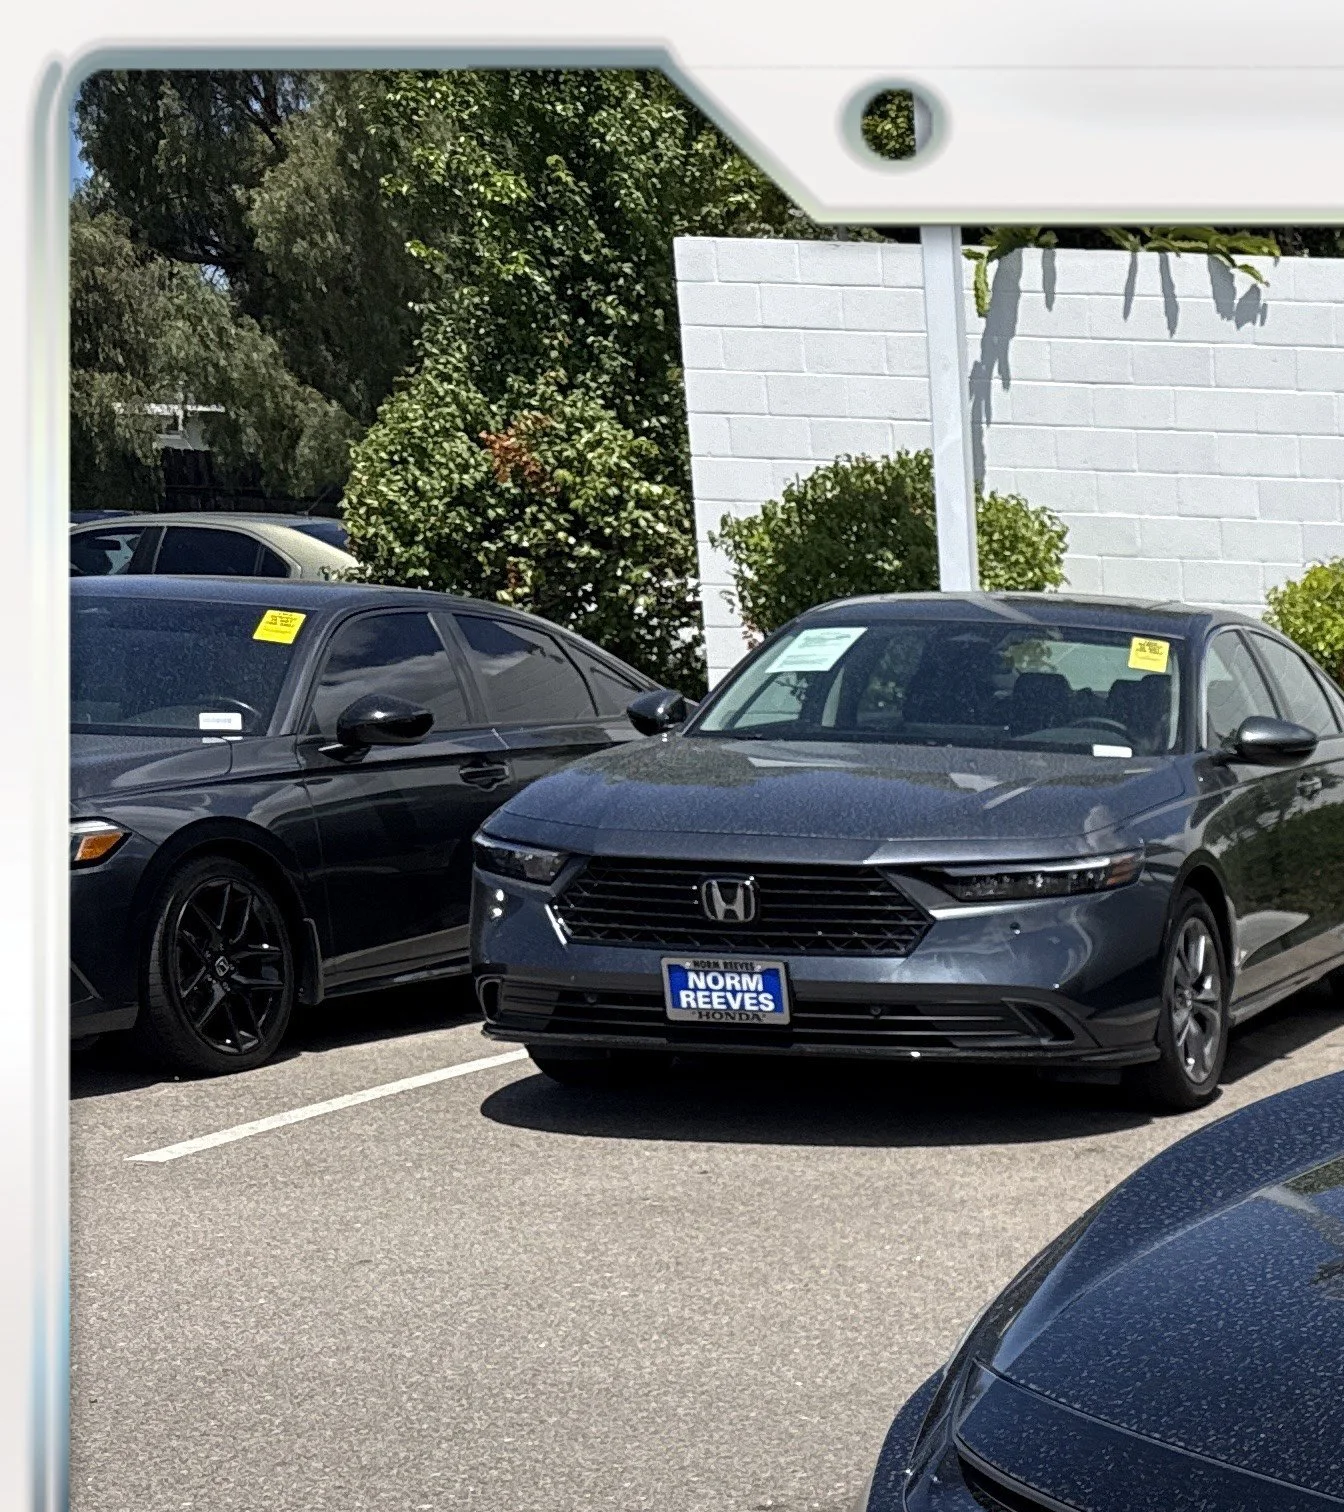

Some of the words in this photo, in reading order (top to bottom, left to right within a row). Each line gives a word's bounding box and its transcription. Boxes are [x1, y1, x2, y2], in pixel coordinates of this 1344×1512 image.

[693, 960, 721, 969] NORM
[687, 971, 764, 992] NORM
[679, 989, 775, 1012] REEVES
[697, 1011, 763, 1022] HONDA
